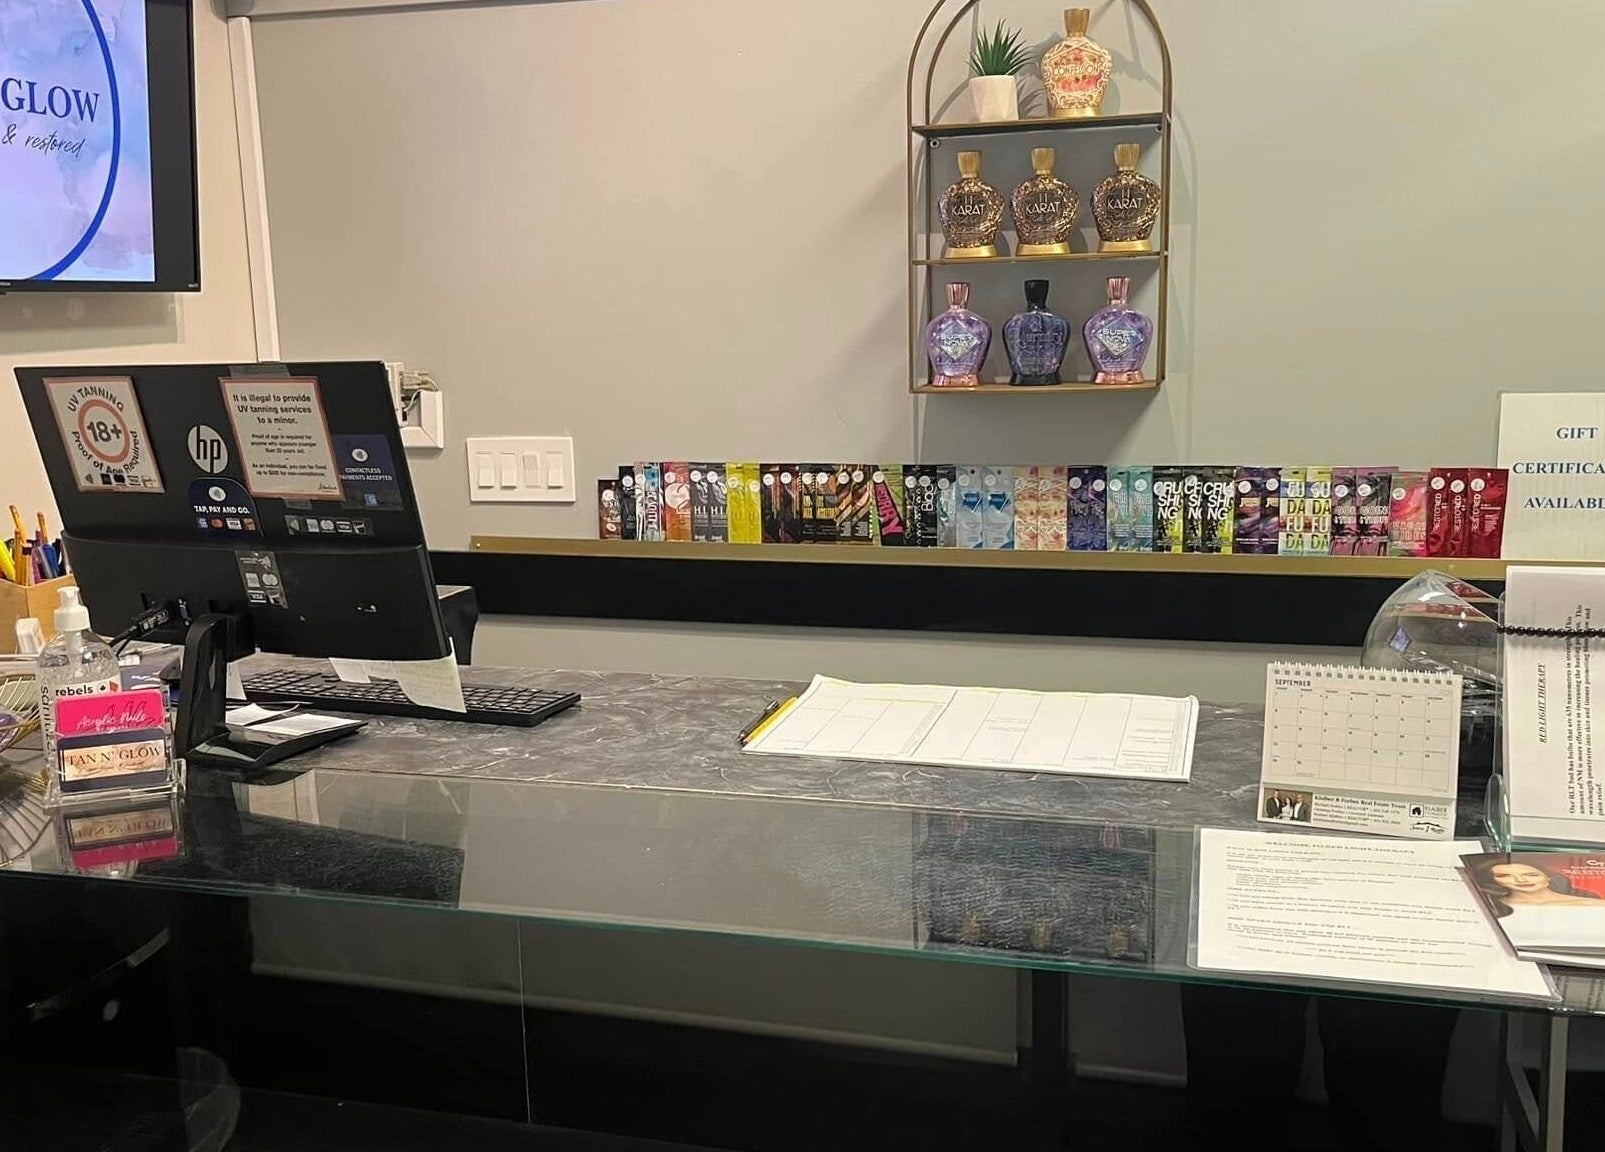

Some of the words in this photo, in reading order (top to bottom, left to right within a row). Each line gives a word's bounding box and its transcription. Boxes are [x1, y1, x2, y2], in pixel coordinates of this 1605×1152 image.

[0, 77, 100, 123] GLOW
[2, 124, 17, 145] &
[25, 130, 86, 158] restored
[952, 204, 985, 216] KARAT
[1025, 202, 1061, 214] KARAT
[1107, 197, 1142, 210] KARAT
[68, 395, 79, 412] UV
[77, 386, 124, 412] TANNING
[273, 394, 281, 402] to
[282, 394, 311, 403] provide
[250, 406, 278, 414] tanning
[87, 421, 122, 442] 18+
[1556, 427, 1598, 439] GIFT
[72, 431, 93, 460] Proof
[93, 461, 103, 470] of
[123, 430, 140, 474] Required
[196, 426, 221, 473] hp
[1512, 462, 1605, 474] CERTIFICA
[194, 505, 209, 514] TAP,
[209, 505, 222, 513] PAY
[238, 506, 250, 514] GO.
[1158, 507, 1178, 519] NG
[1207, 507, 1228, 520] NG
[1287, 499, 1305, 515] DA
[1312, 499, 1331, 515] DA
[1286, 516, 1303, 532] FU
[1312, 516, 1329, 532] FU
[1286, 533, 1303, 548] DA
[1311, 534, 1329, 549] DA
[1275, 679, 1311, 688] SEPTEMBER
[1537, 663, 1547, 698] THERAPY
[55, 684, 93, 696] rebels
[1538, 699, 1547, 726] LIGHT
[1539, 727, 1547, 743] RED
[67, 751, 97, 767] TAN
[100, 750, 115, 764] N'
[118, 745, 162, 760] GLOW
